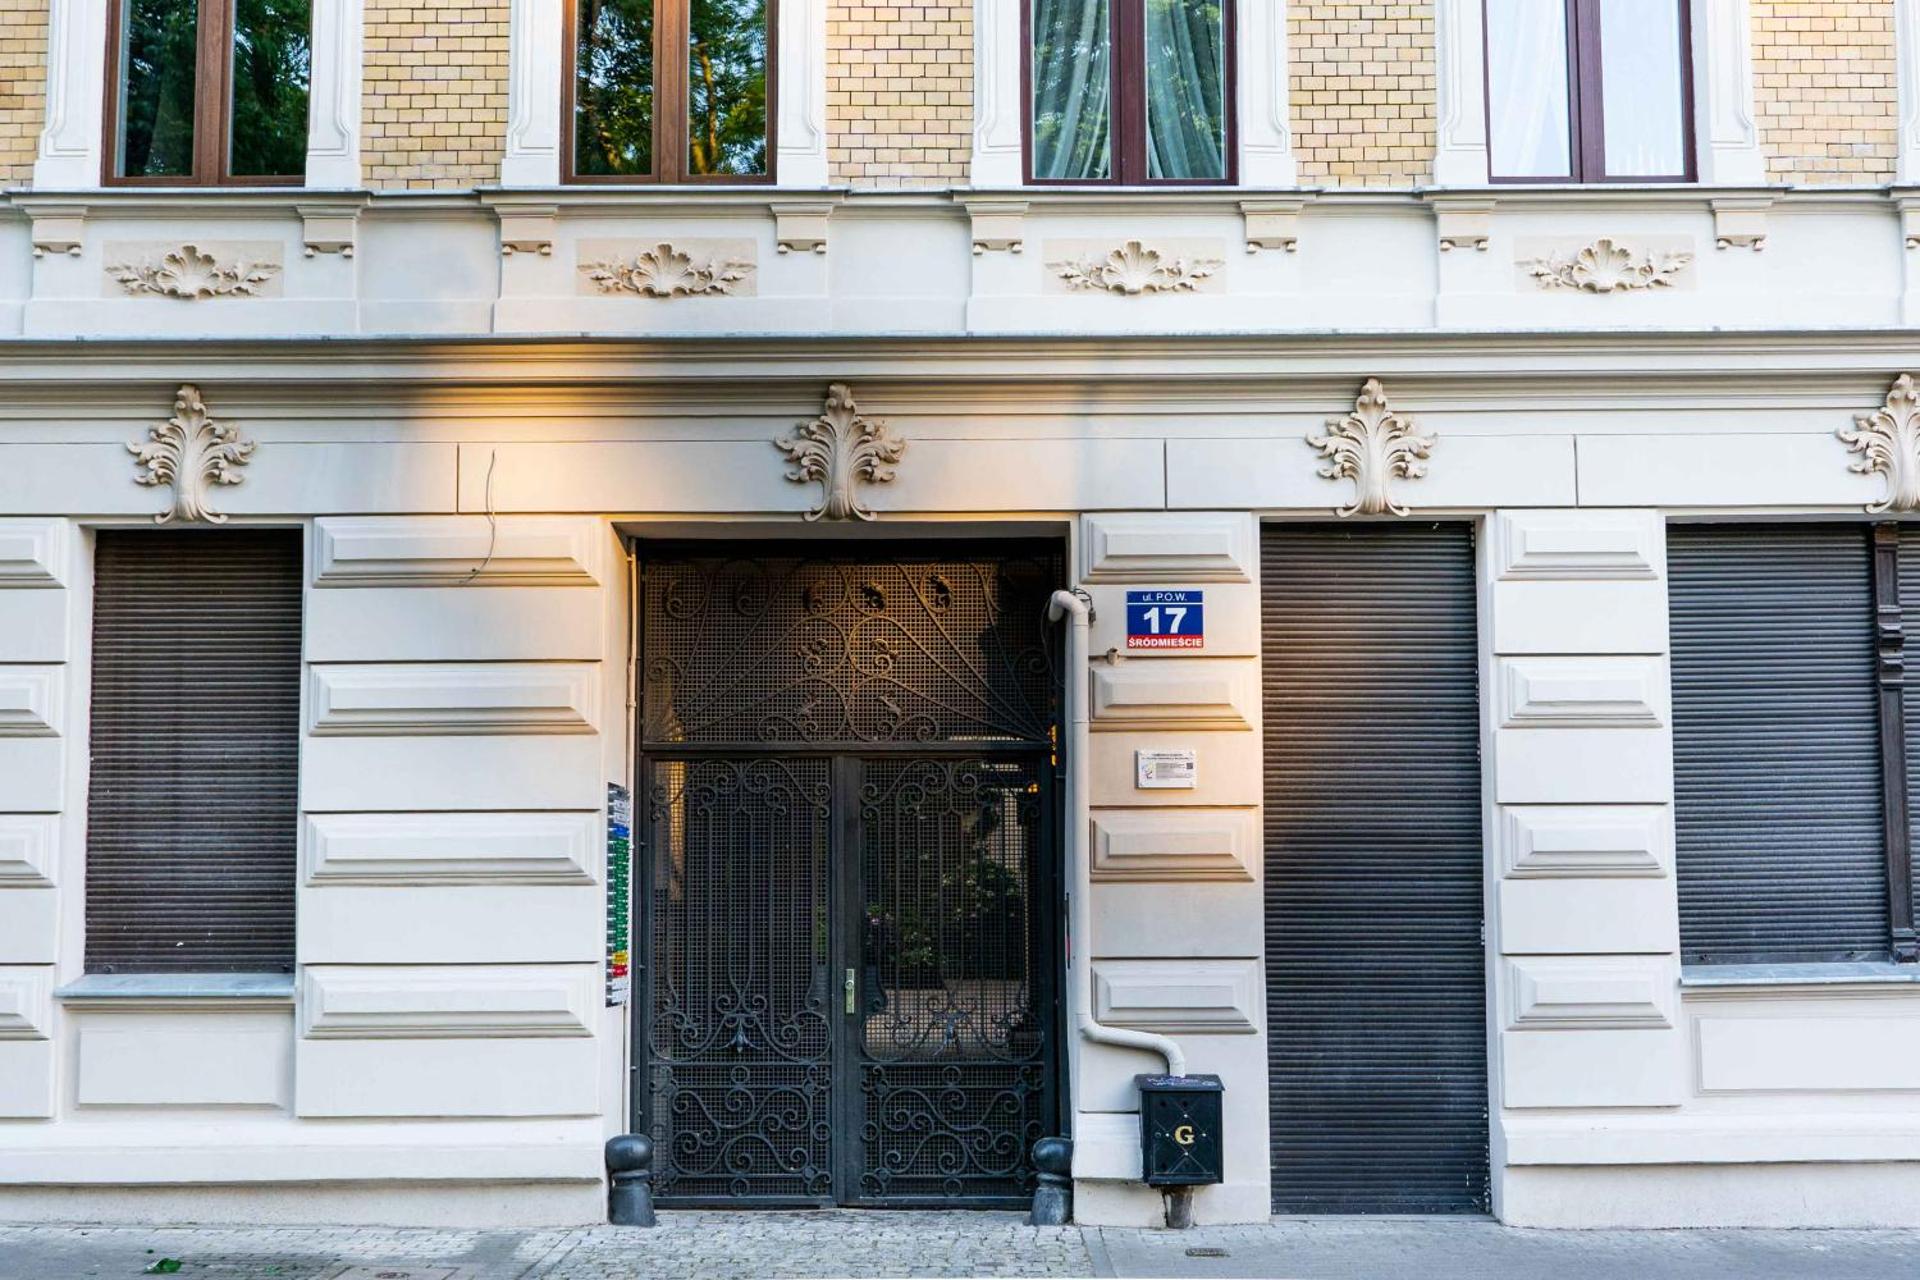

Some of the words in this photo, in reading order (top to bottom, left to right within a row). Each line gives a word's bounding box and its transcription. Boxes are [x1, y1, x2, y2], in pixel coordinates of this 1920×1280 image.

[1142, 593, 1153, 601] ul.
[1156, 593, 1187, 601] P.O.W.
[1143, 607, 1187, 634] 17
[1128, 637, 1202, 647] ŚRÓDMIEŚCIE
[1174, 1125, 1195, 1145] G
